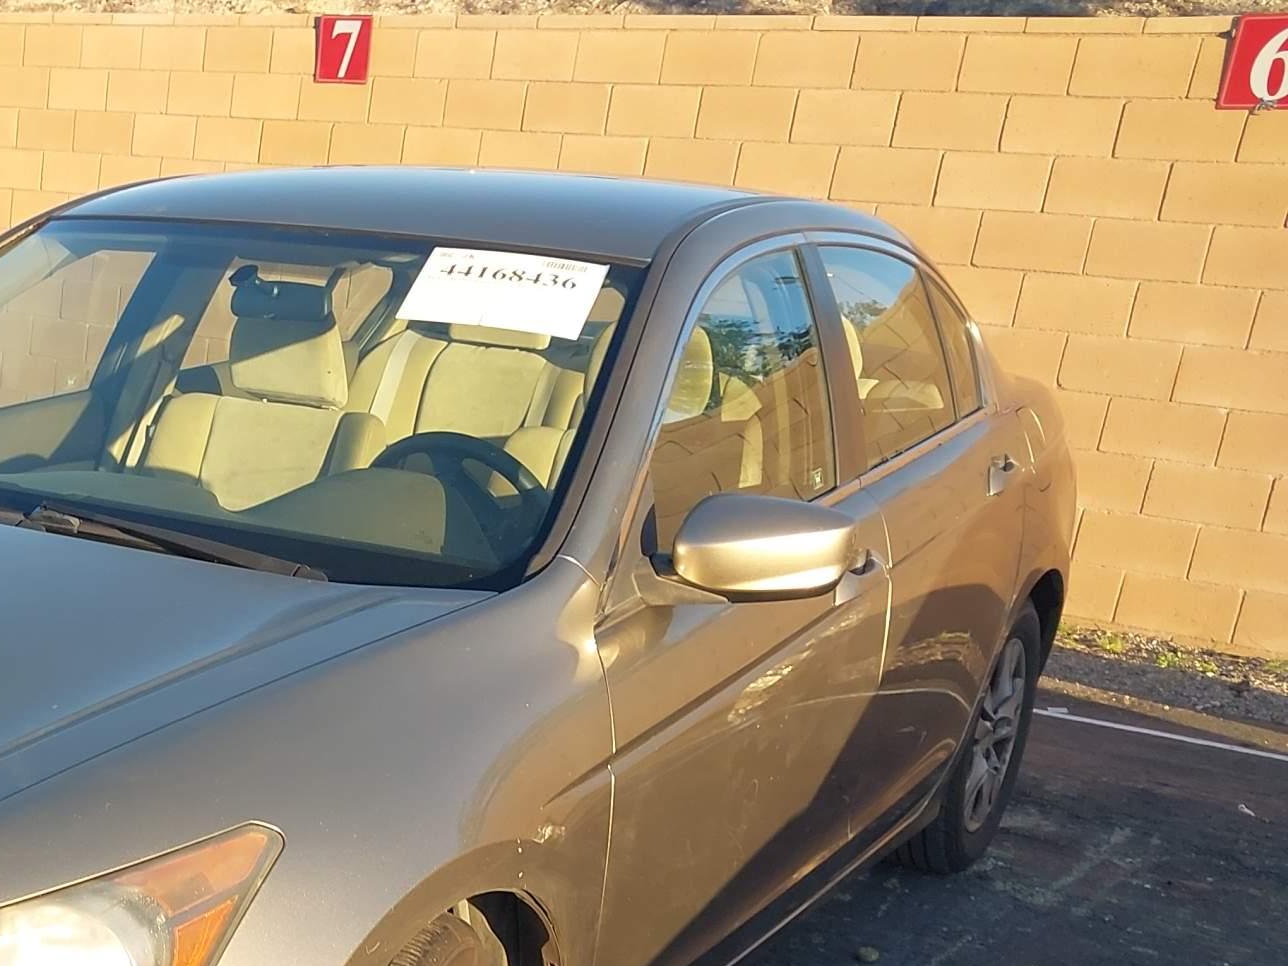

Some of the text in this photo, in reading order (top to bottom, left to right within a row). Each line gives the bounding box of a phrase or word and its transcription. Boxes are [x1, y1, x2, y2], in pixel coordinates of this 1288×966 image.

[331, 20, 363, 78] 7
[1249, 27, 1288, 101] 6
[440, 263, 577, 289] 44168436
